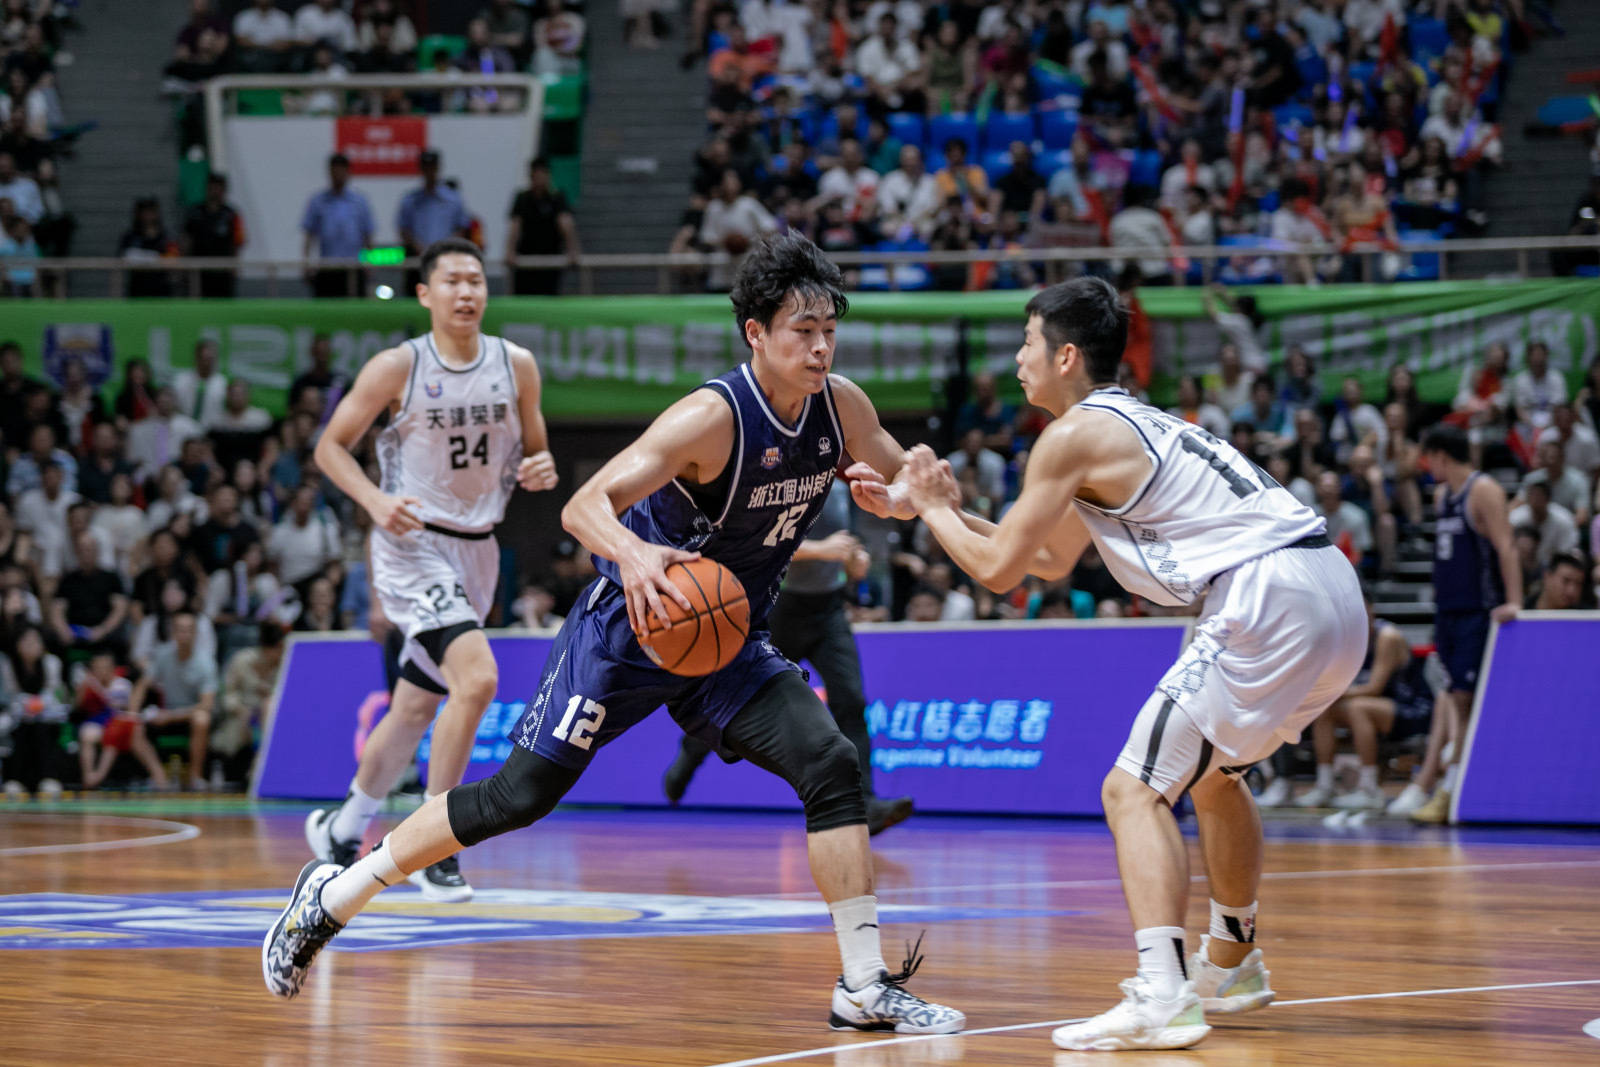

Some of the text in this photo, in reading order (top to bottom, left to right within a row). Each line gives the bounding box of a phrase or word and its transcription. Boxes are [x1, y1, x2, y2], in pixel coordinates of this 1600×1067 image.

[449, 433, 490, 470] 24
[762, 503, 808, 547] 12
[552, 694, 606, 751] 12
[947, 744, 1044, 769] Volunteer
